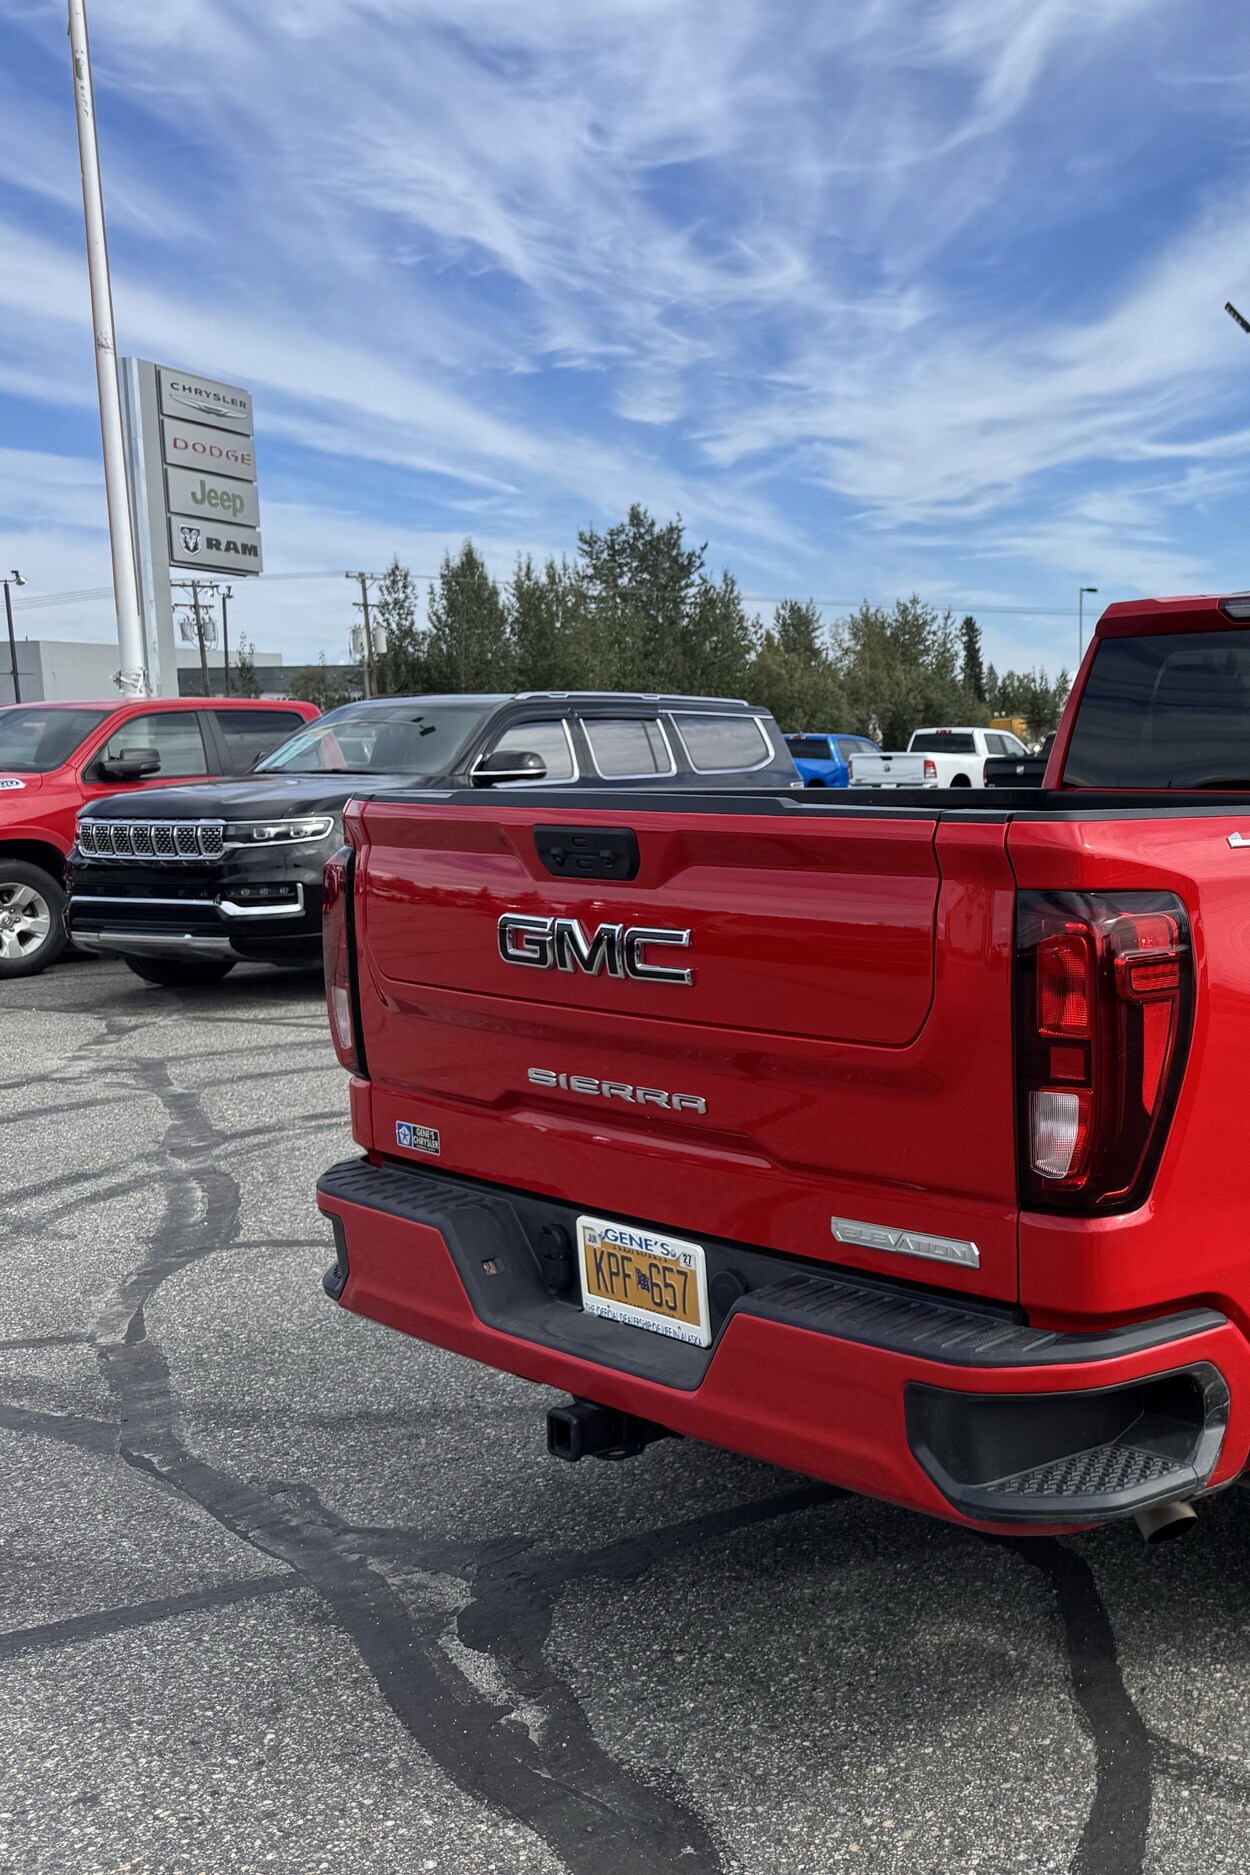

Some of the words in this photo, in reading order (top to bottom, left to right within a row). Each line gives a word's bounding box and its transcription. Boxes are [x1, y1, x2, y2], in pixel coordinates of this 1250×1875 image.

[170, 381, 247, 410] CHRYSLER
[173, 436, 252, 465] DODGE
[191, 479, 245, 518] Jeep
[206, 536, 259, 558] RAM
[497, 912, 696, 986] GMC
[527, 1067, 708, 1115] SIERRA
[604, 1228, 670, 1257] GENE'S
[844, 1225, 967, 1261] ELEVATION
[593, 1247, 633, 1298] KPF
[649, 1262, 689, 1315] 657
